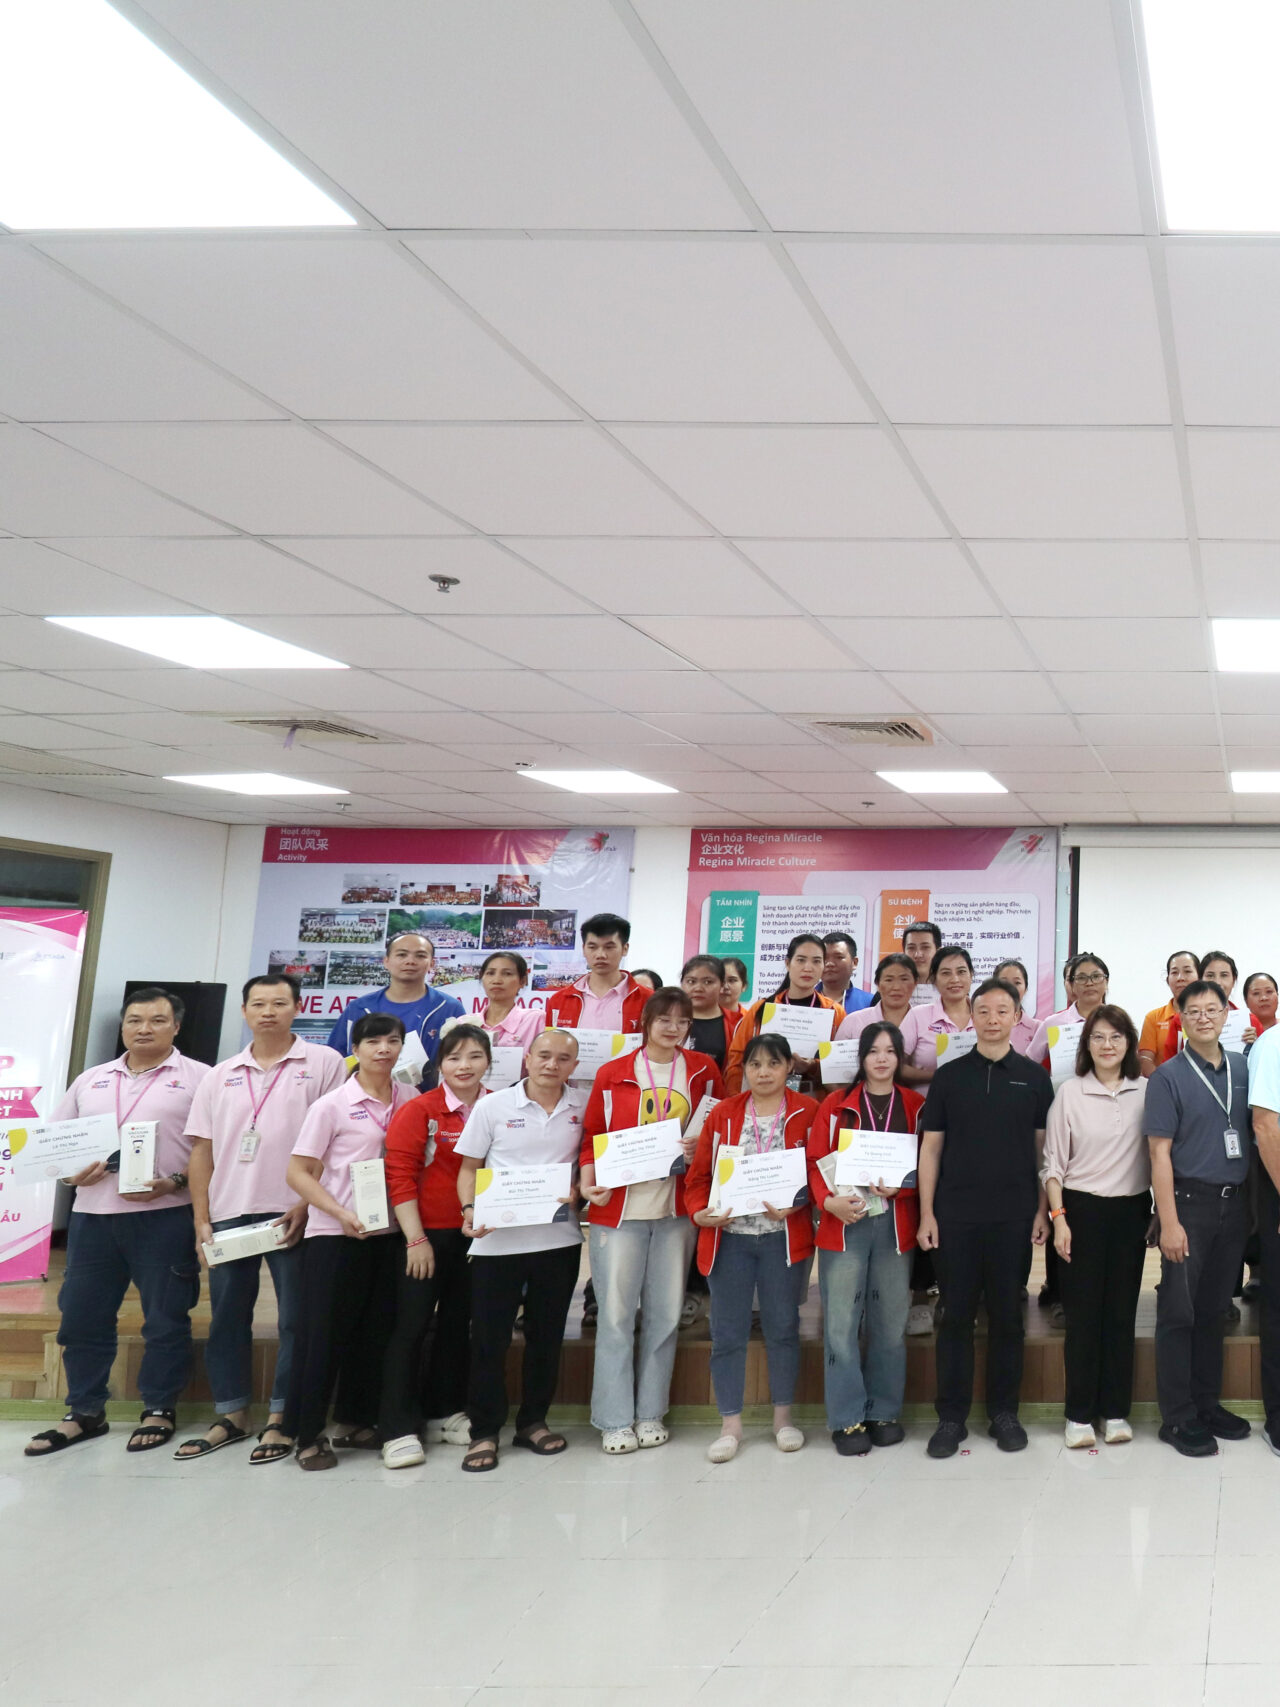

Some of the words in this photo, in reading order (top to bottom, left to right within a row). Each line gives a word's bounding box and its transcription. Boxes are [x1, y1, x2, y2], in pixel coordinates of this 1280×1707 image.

[280, 838, 328, 850] 团队风采
[746, 834, 780, 844] Regina
[784, 833, 822, 842] Miracle
[701, 844, 744, 854] 企业文化
[277, 854, 307, 862] Activity
[698, 857, 734, 868] Regina
[736, 856, 776, 866] Miracle
[778, 857, 817, 866] Culture
[721, 916, 745, 928] 企业
[894, 914, 916, 926] 企业
[720, 930, 744, 942] 愿景
[1, 1210, 21, 1222] ẦU
